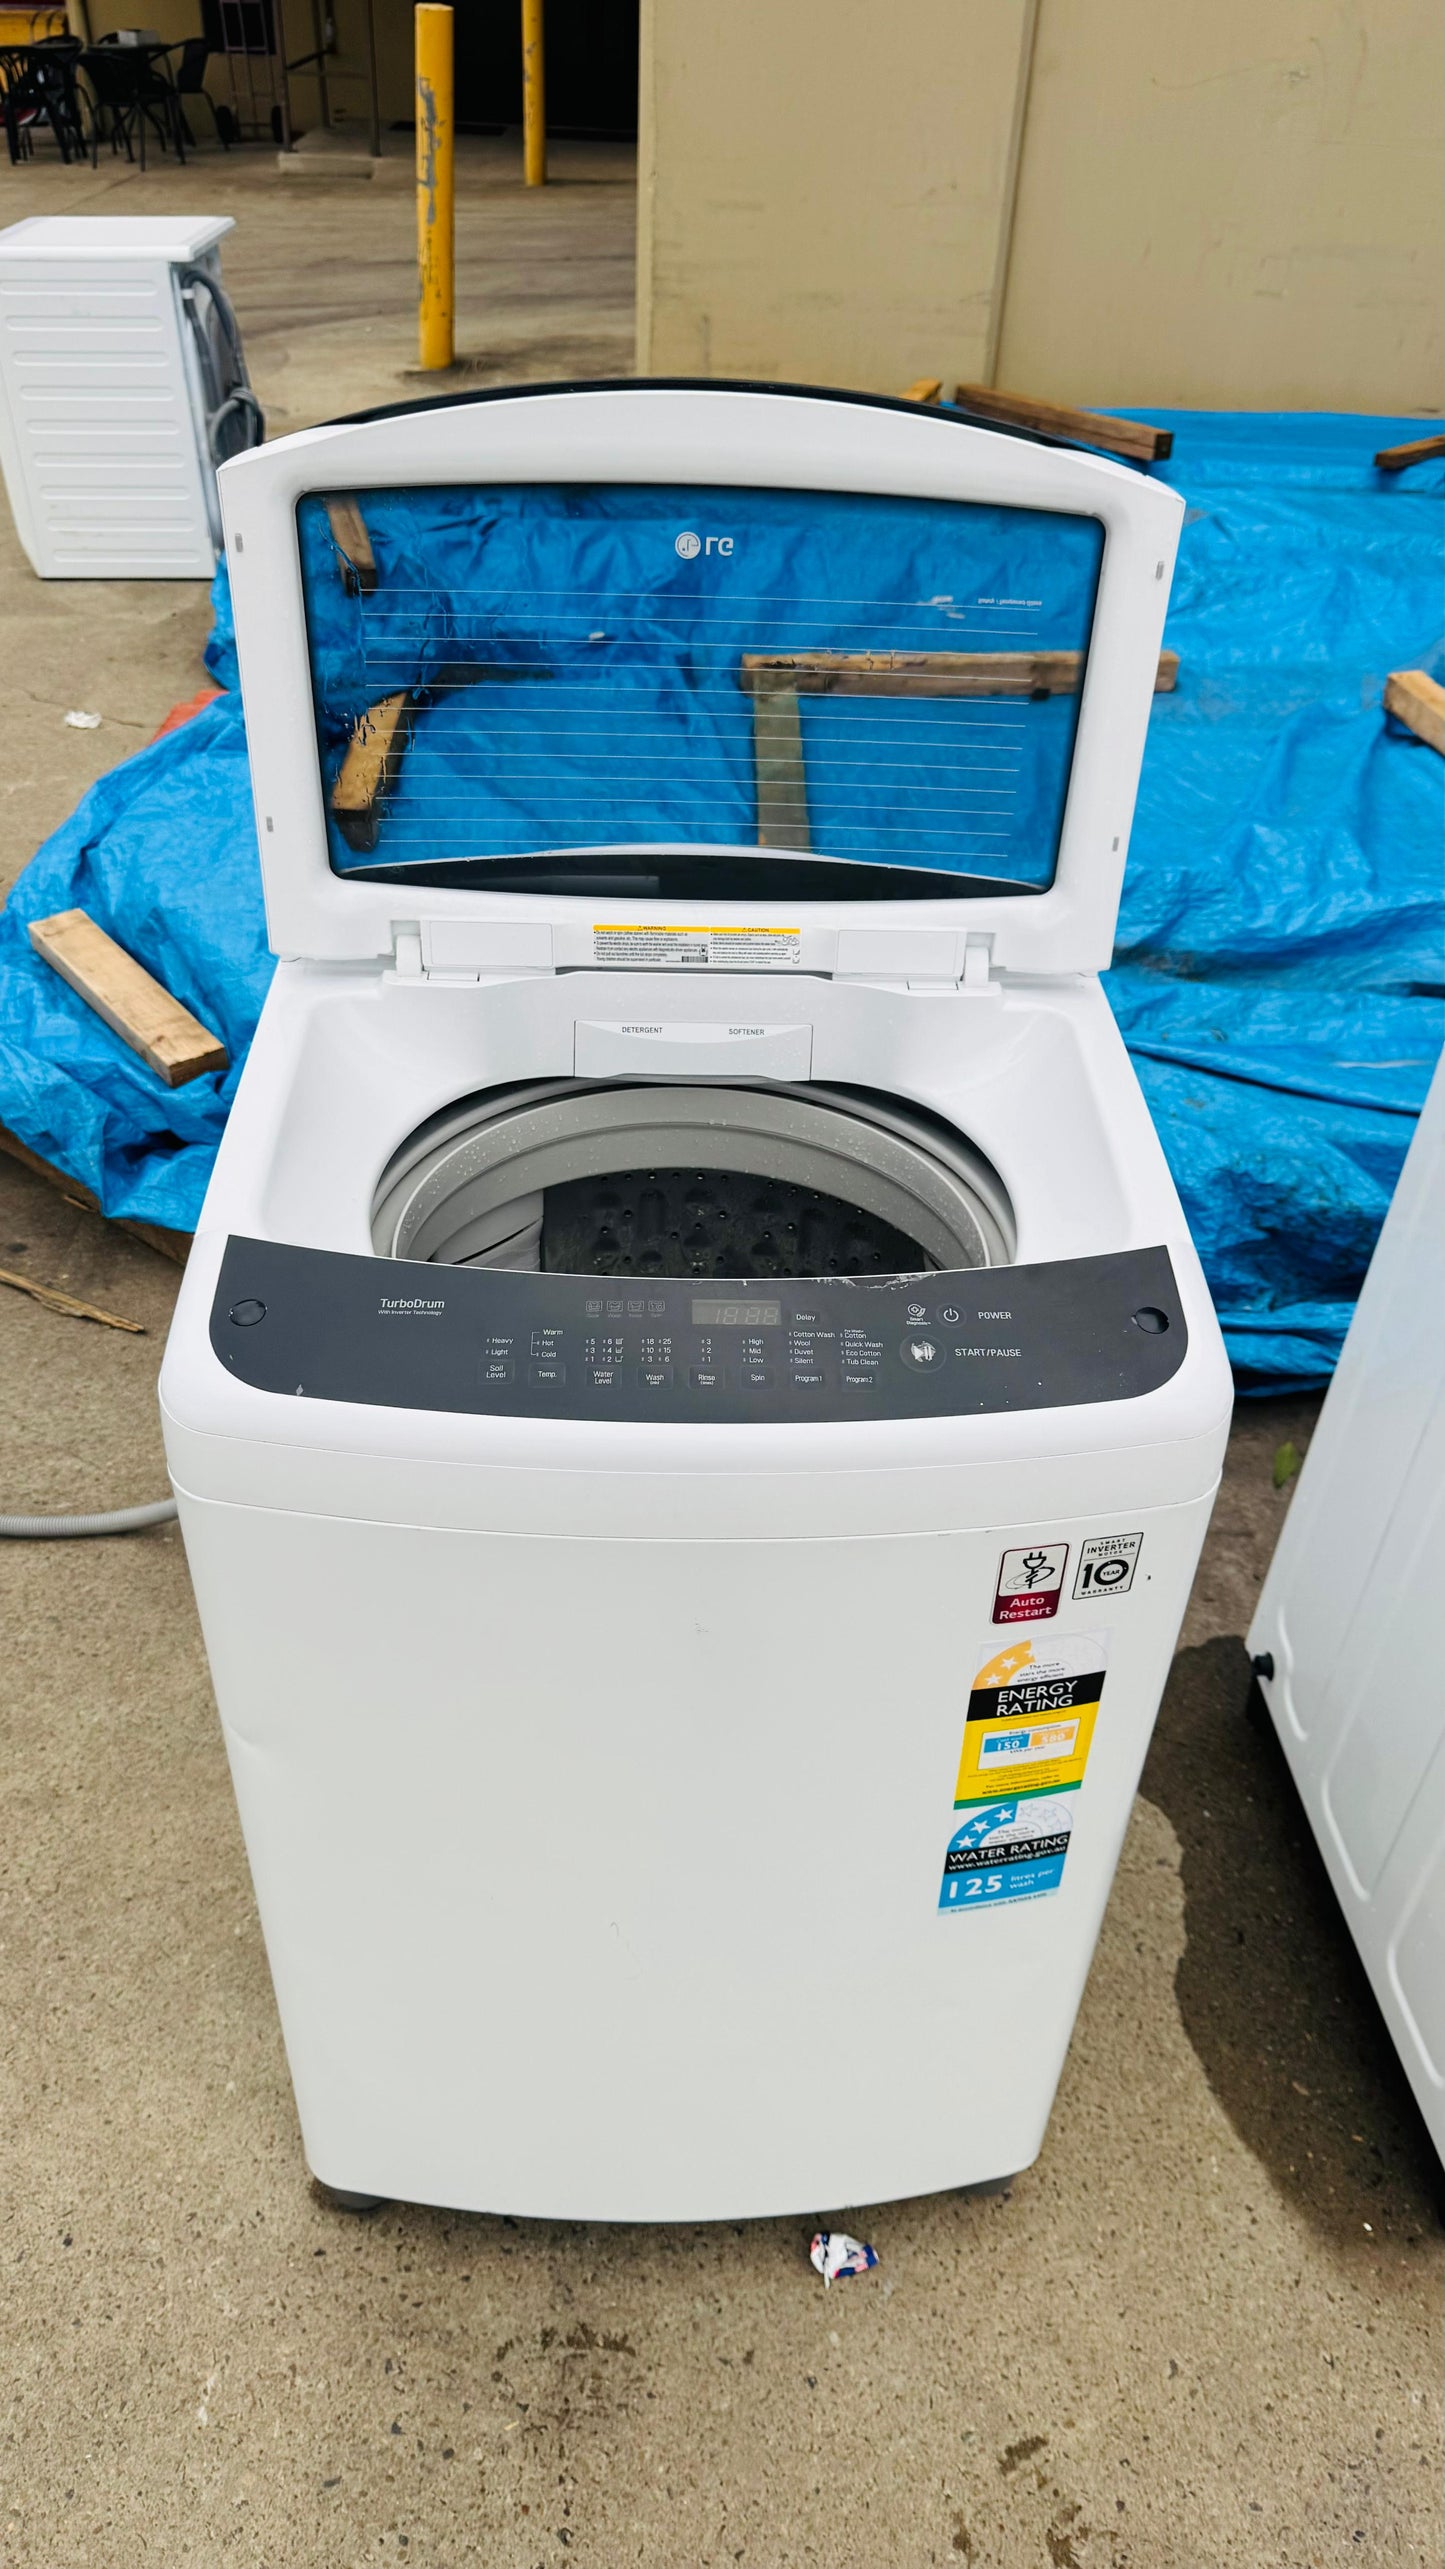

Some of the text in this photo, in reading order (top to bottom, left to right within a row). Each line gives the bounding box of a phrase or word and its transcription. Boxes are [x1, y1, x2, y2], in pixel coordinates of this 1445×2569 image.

[621, 1026, 663, 1034] DETERGENT
[728, 1028, 765, 1036] SOFTENER
[380, 1298, 445, 1309] TurboDrum
[748, 1338, 764, 1346] High
[954, 1349, 1022, 1357] START/PAUSE
[489, 1364, 504, 1372] Soil
[538, 1370, 557, 1379] Temp.
[750, 1374, 766, 1382] Spin
[795, 1374, 819, 1383] Program
[594, 1377, 612, 1385] Level
[846, 1376, 868, 1384] Program
[1087, 1541, 1136, 1554] INVERTER
[1082, 1559, 1129, 1589] 10
[1081, 1585, 1124, 1595] WARRANTY
[1010, 1597, 1045, 1608] Auto
[999, 1606, 1052, 1620] Restart
[998, 1680, 1078, 1703] ENERGY
[996, 1695, 1074, 1716] RATING
[997, 1740, 1020, 1751] 150
[949, 1835, 1069, 1863] WATER RATING
[948, 1845, 1066, 1871] www.waterrating.gov.au
[1010, 1869, 1055, 1882] litres per
[949, 1874, 1003, 1899] 125
[1009, 1880, 1034, 1889] wash
